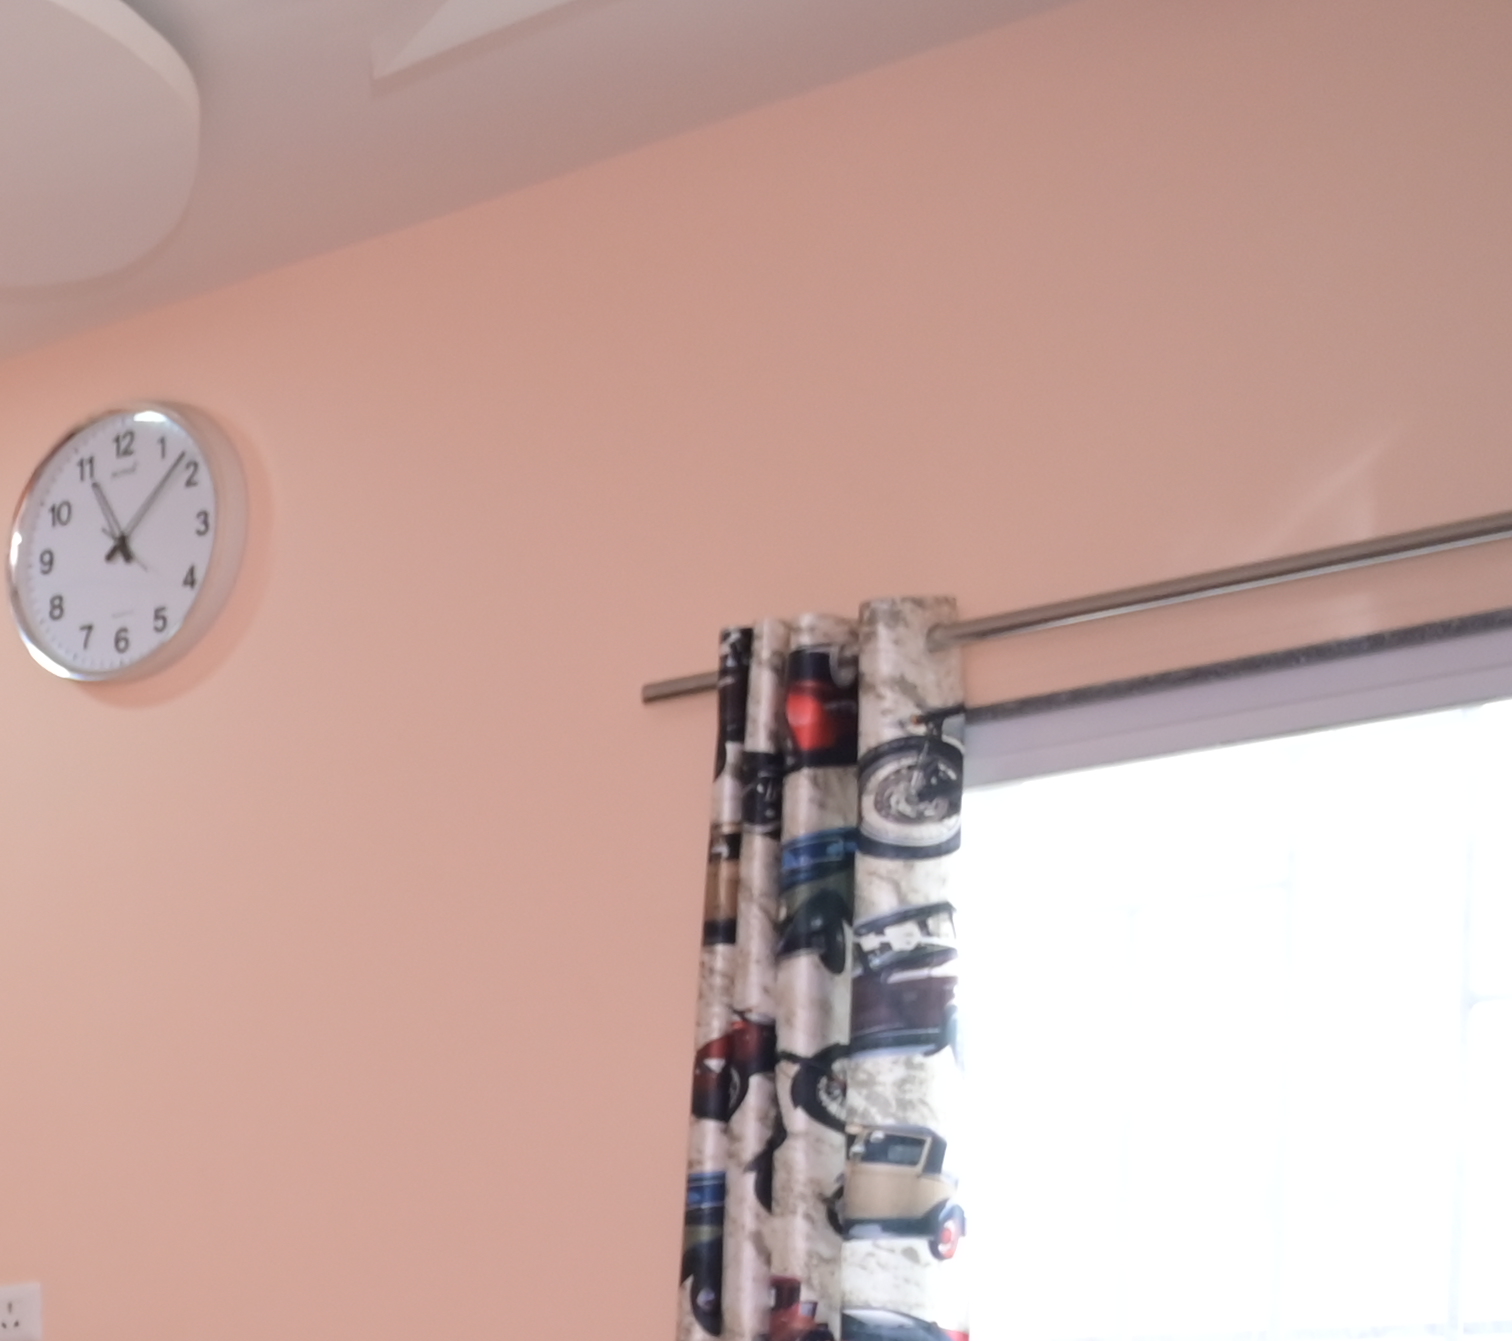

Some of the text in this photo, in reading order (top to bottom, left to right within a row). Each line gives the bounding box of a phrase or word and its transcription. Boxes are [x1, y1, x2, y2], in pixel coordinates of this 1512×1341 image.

[113, 431, 136, 458] 12
[157, 436, 166, 459] 1
[77, 456, 95, 482] 11
[184, 460, 199, 488] 2
[49, 500, 72, 527] 10
[195, 510, 209, 536] 3
[39, 548, 54, 575] 9
[182, 563, 197, 590] 4
[48, 595, 64, 621] 8
[153, 607, 168, 633] 5
[79, 624, 94, 650] 7
[114, 627, 130, 653] 6
